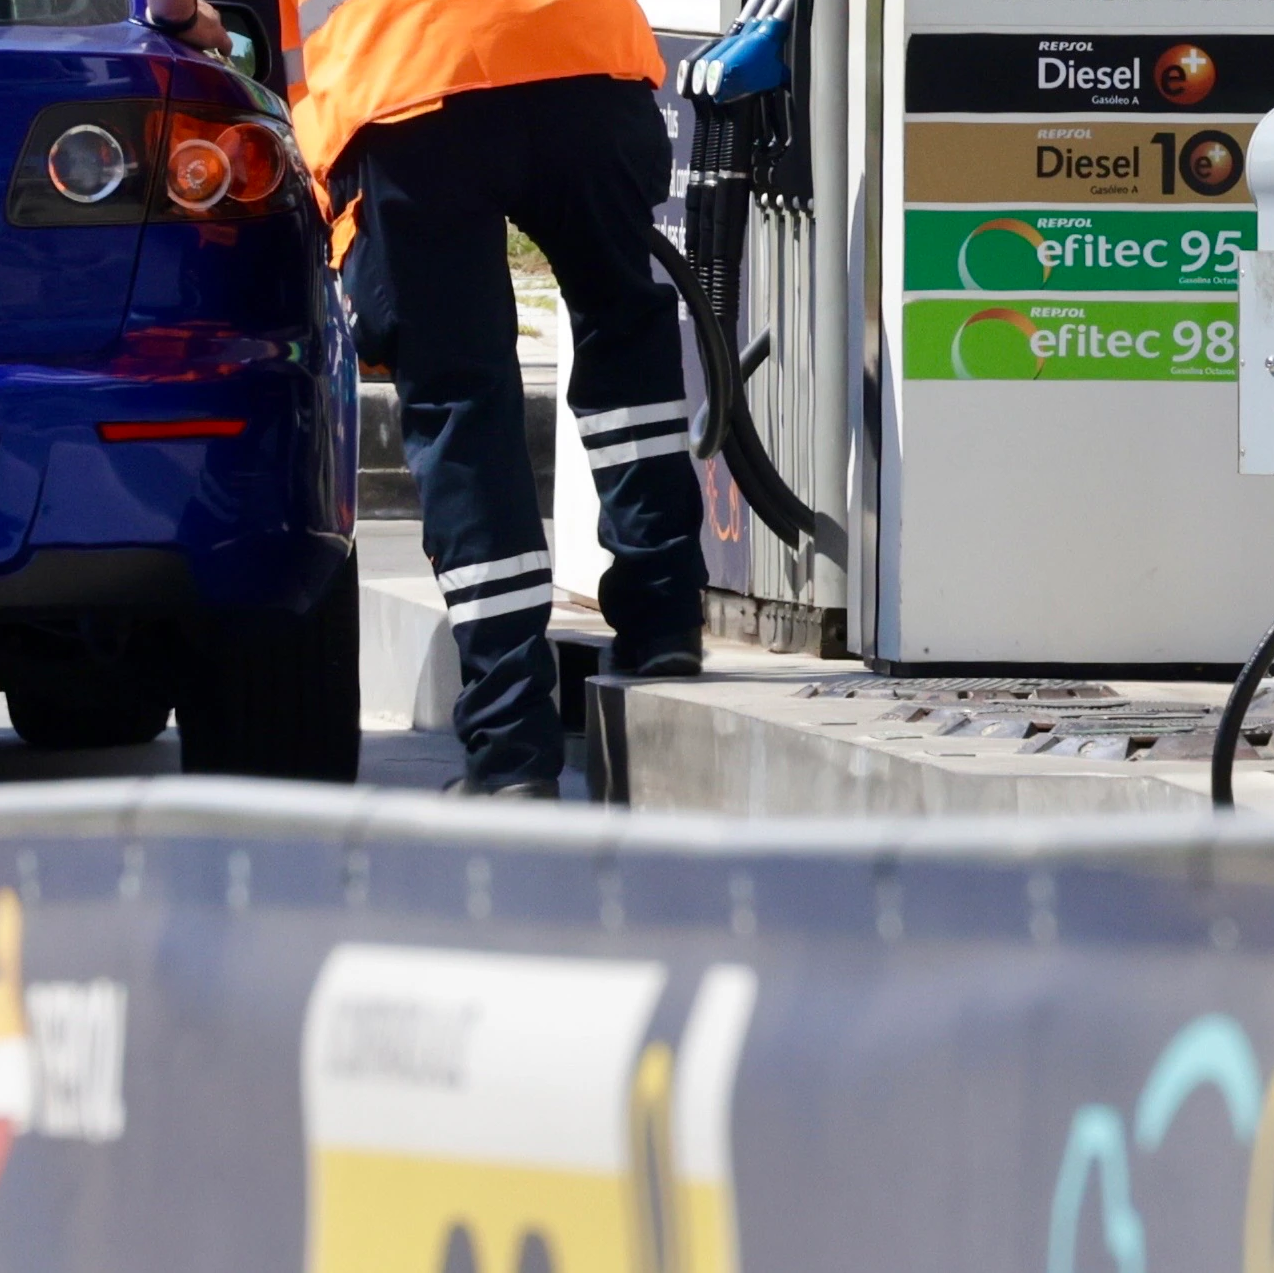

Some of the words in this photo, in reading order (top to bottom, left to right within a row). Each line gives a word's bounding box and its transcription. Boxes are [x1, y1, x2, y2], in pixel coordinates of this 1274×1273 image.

[1038, 41, 1094, 52] REPSOL
[1037, 57, 1140, 89] Diesel
[1091, 94, 1129, 105] Gasóleo
[1037, 129, 1093, 139] REPSOL
[1036, 146, 1140, 179] Diesel
[1090, 185, 1128, 196] Gasóleo
[1037, 217, 1093, 228] REPSOL
[1036, 231, 1167, 269] efitec
[1180, 230, 1241, 273] 95
[1030, 307, 1085, 318] REPSOL
[1029, 320, 1160, 358] efitec
[1172, 320, 1235, 363] 98
